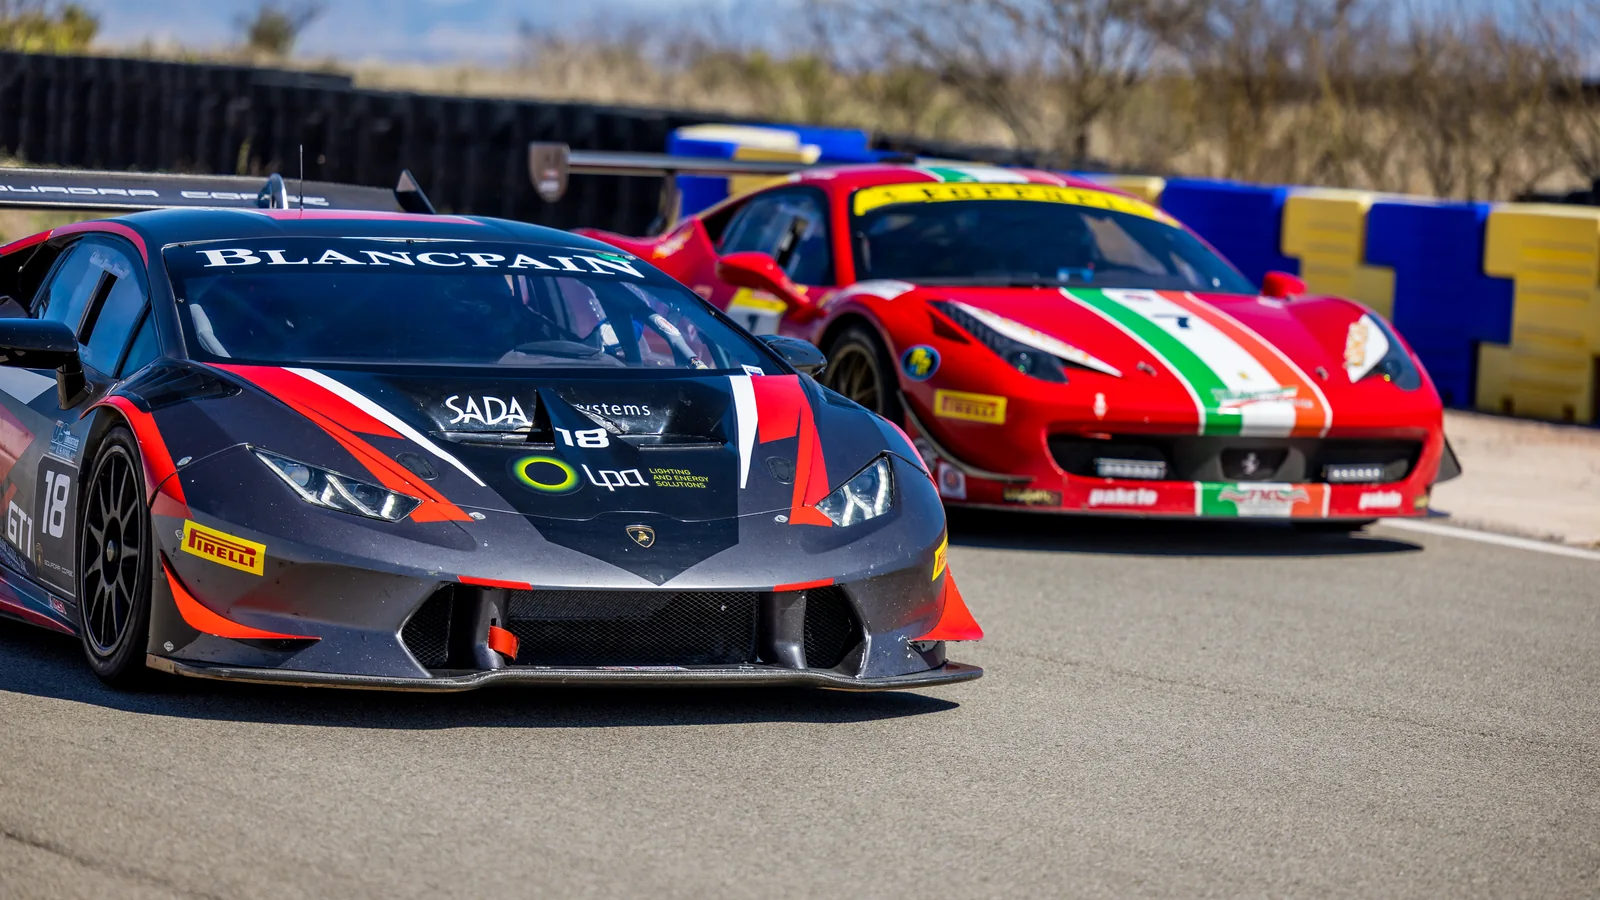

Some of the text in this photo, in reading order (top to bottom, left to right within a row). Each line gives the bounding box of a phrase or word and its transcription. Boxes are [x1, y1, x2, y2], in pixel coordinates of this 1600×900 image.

[0, 185, 160, 198] UADRA
[195, 247, 646, 279] BLANCPAIN
[445, 395, 651, 425] SADA ystems
[555, 427, 611, 448] 18
[649, 467, 691, 476] LIGHTING
[674, 475, 709, 483] ENERGY
[42, 470, 71, 538] 18
[188, 527, 257, 568] PIRELLI
